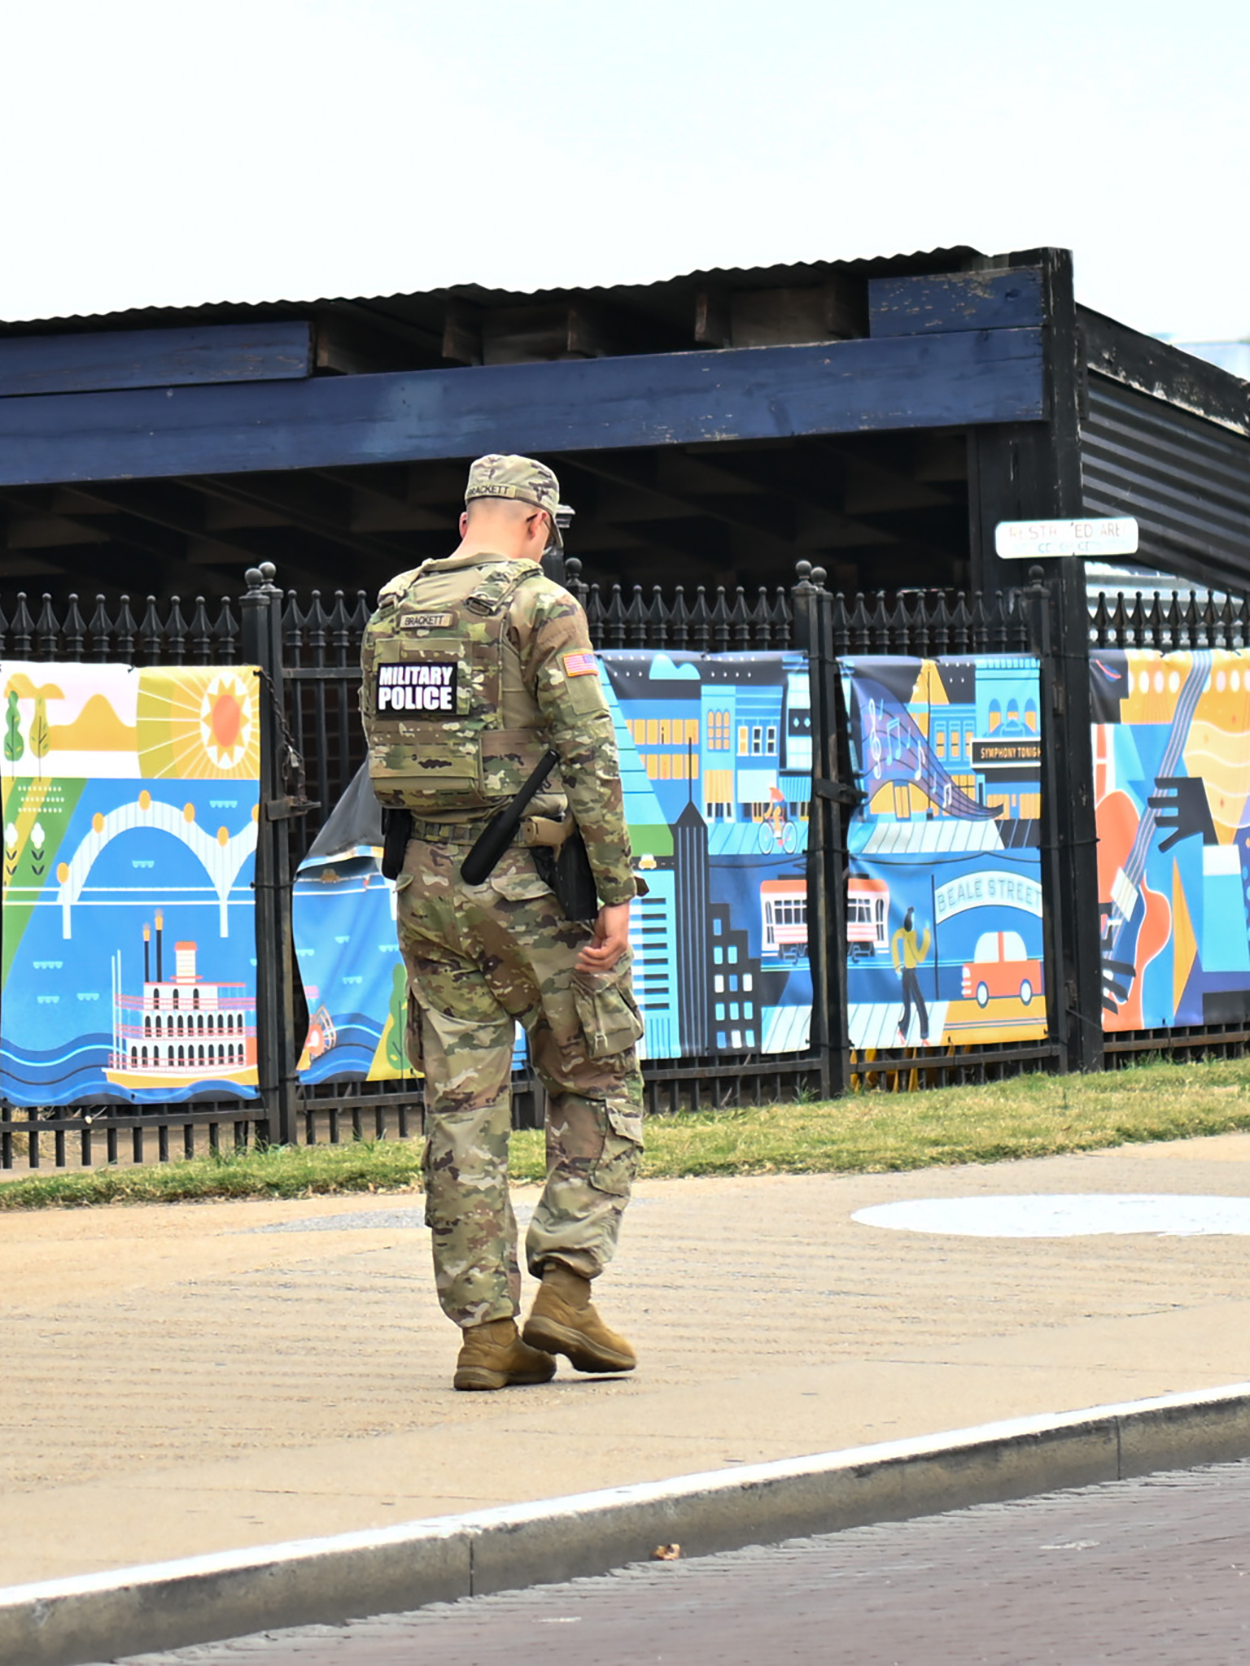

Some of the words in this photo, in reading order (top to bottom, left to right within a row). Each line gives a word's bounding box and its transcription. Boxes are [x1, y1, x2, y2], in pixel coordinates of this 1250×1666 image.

[404, 615, 444, 626] BRACKETT
[379, 666, 453, 686] MILITARY
[378, 686, 453, 710] POLICE
[980, 746, 1017, 760] SYMPHONY
[937, 880, 983, 913] BEALE
[988, 878, 1042, 910] STREET
